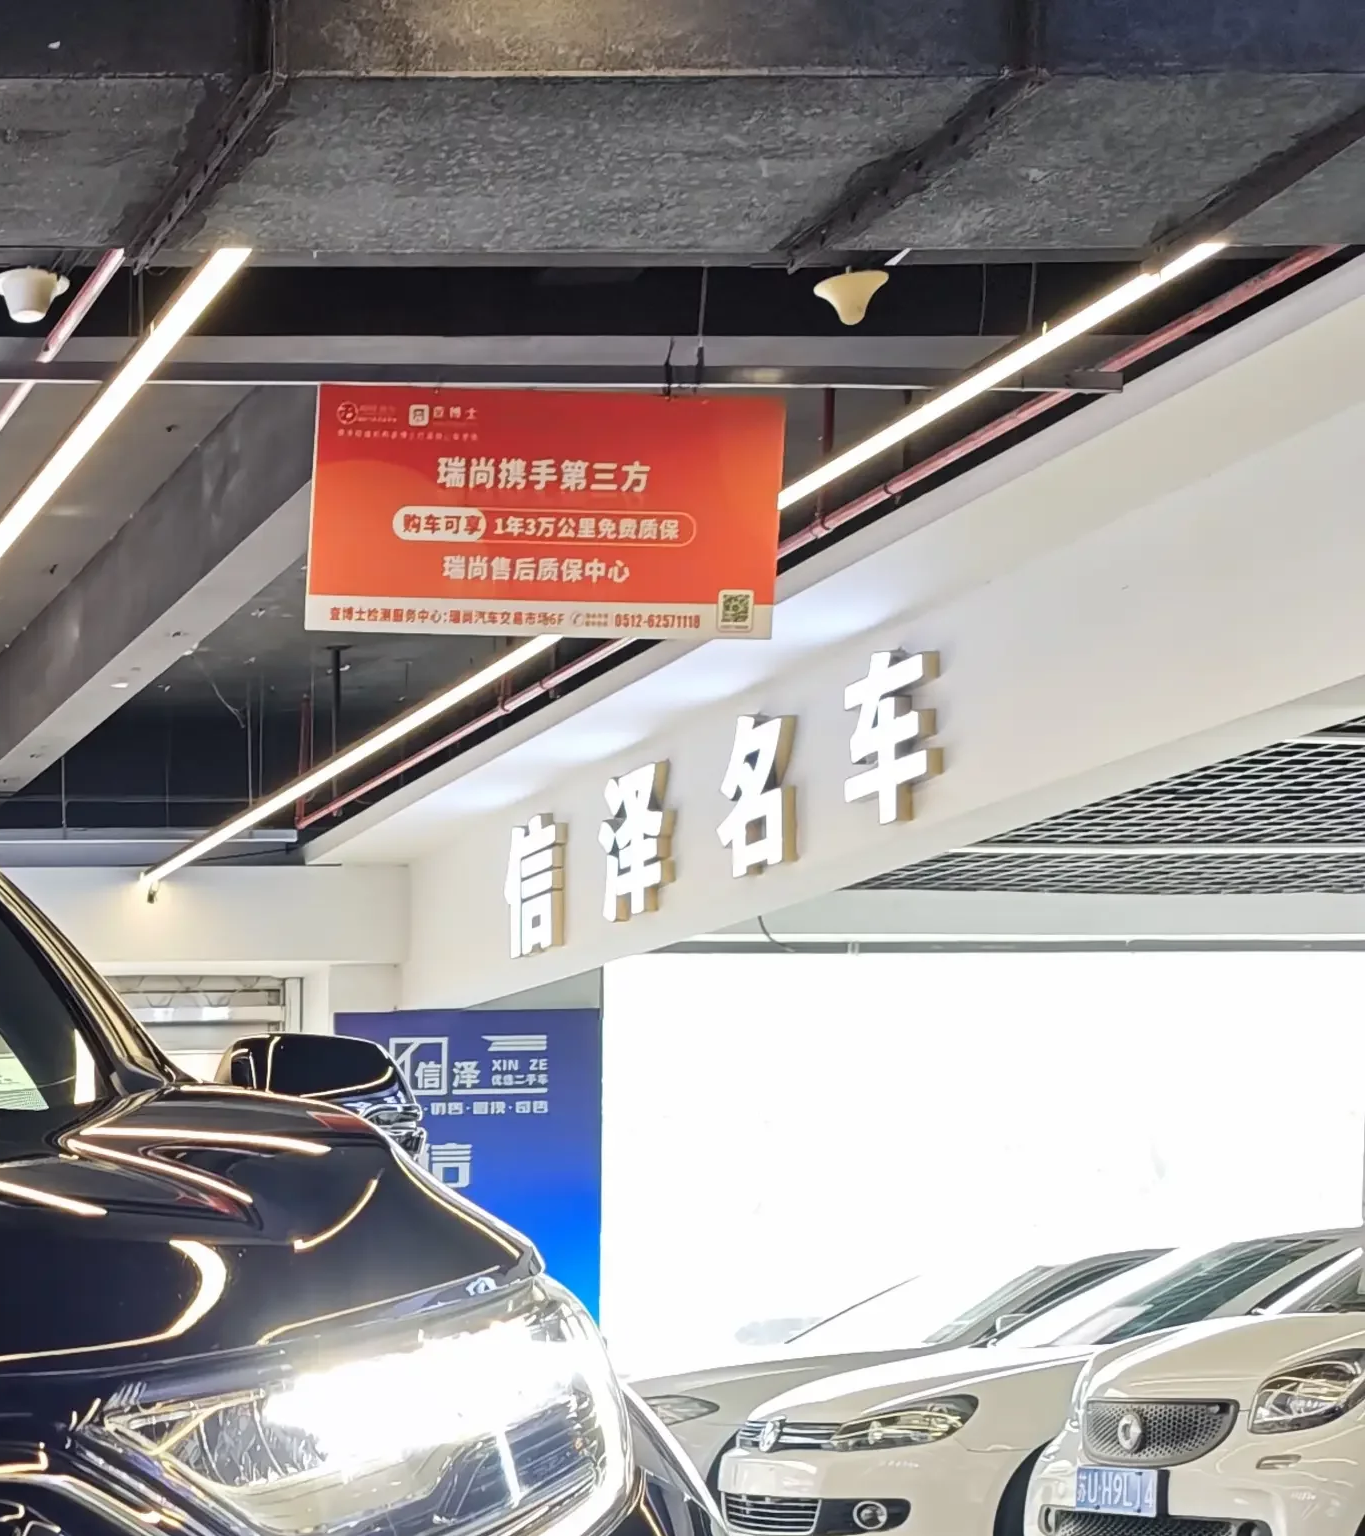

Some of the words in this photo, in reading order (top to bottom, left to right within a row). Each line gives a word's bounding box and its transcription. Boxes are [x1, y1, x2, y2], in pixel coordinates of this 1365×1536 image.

[435, 456, 652, 493] 瑞尚携手第三方
[402, 513, 484, 535] 购车可享
[492, 516, 680, 540] 1年3万公里免费质保
[441, 555, 631, 583] 瑞尚售后质保中心
[503, 648, 942, 960] 信泽名车
[414, 1060, 481, 1089] 信泽
[491, 1058, 519, 1071] XIN
[529, 1058, 549, 1071] ZE
